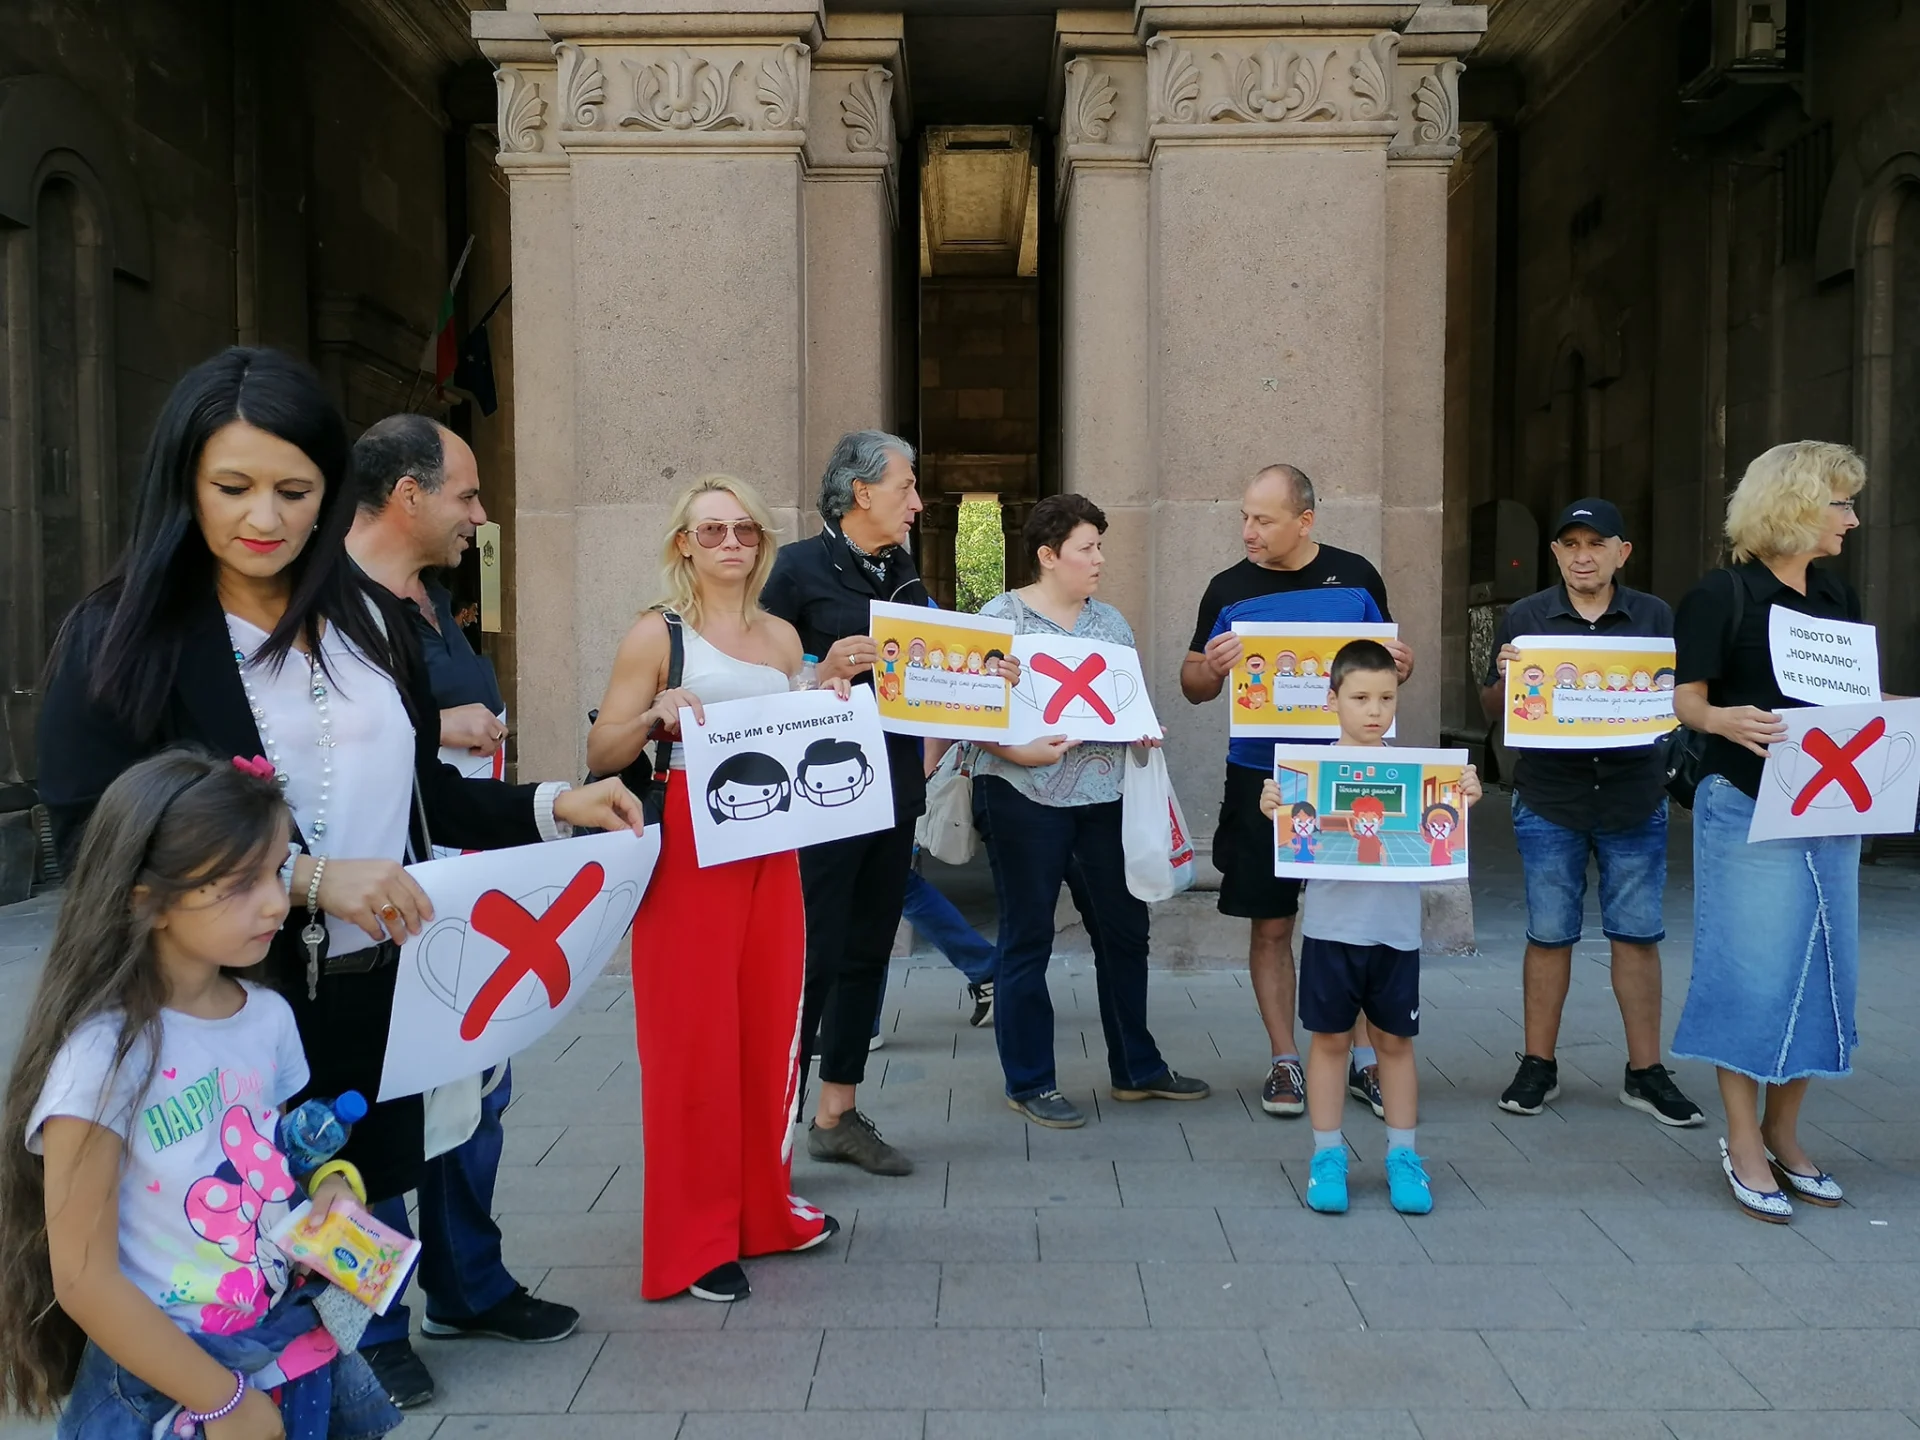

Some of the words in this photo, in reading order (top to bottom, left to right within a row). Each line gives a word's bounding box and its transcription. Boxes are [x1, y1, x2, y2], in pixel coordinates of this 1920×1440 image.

[1789, 626, 1834, 643] НОВОТО
[1837, 635, 1852, 646] ВИ
[1782, 670, 1797, 682] НЕ
[1797, 673, 1804, 684] Е
[1806, 676, 1871, 697] НОРМАЛНО!
[708, 731, 742, 745] Къде
[744, 726, 763, 738] им
[766, 724, 774, 735] е
[776, 710, 854, 736] усмивката?
[143, 1067, 222, 1153] HAPPY
